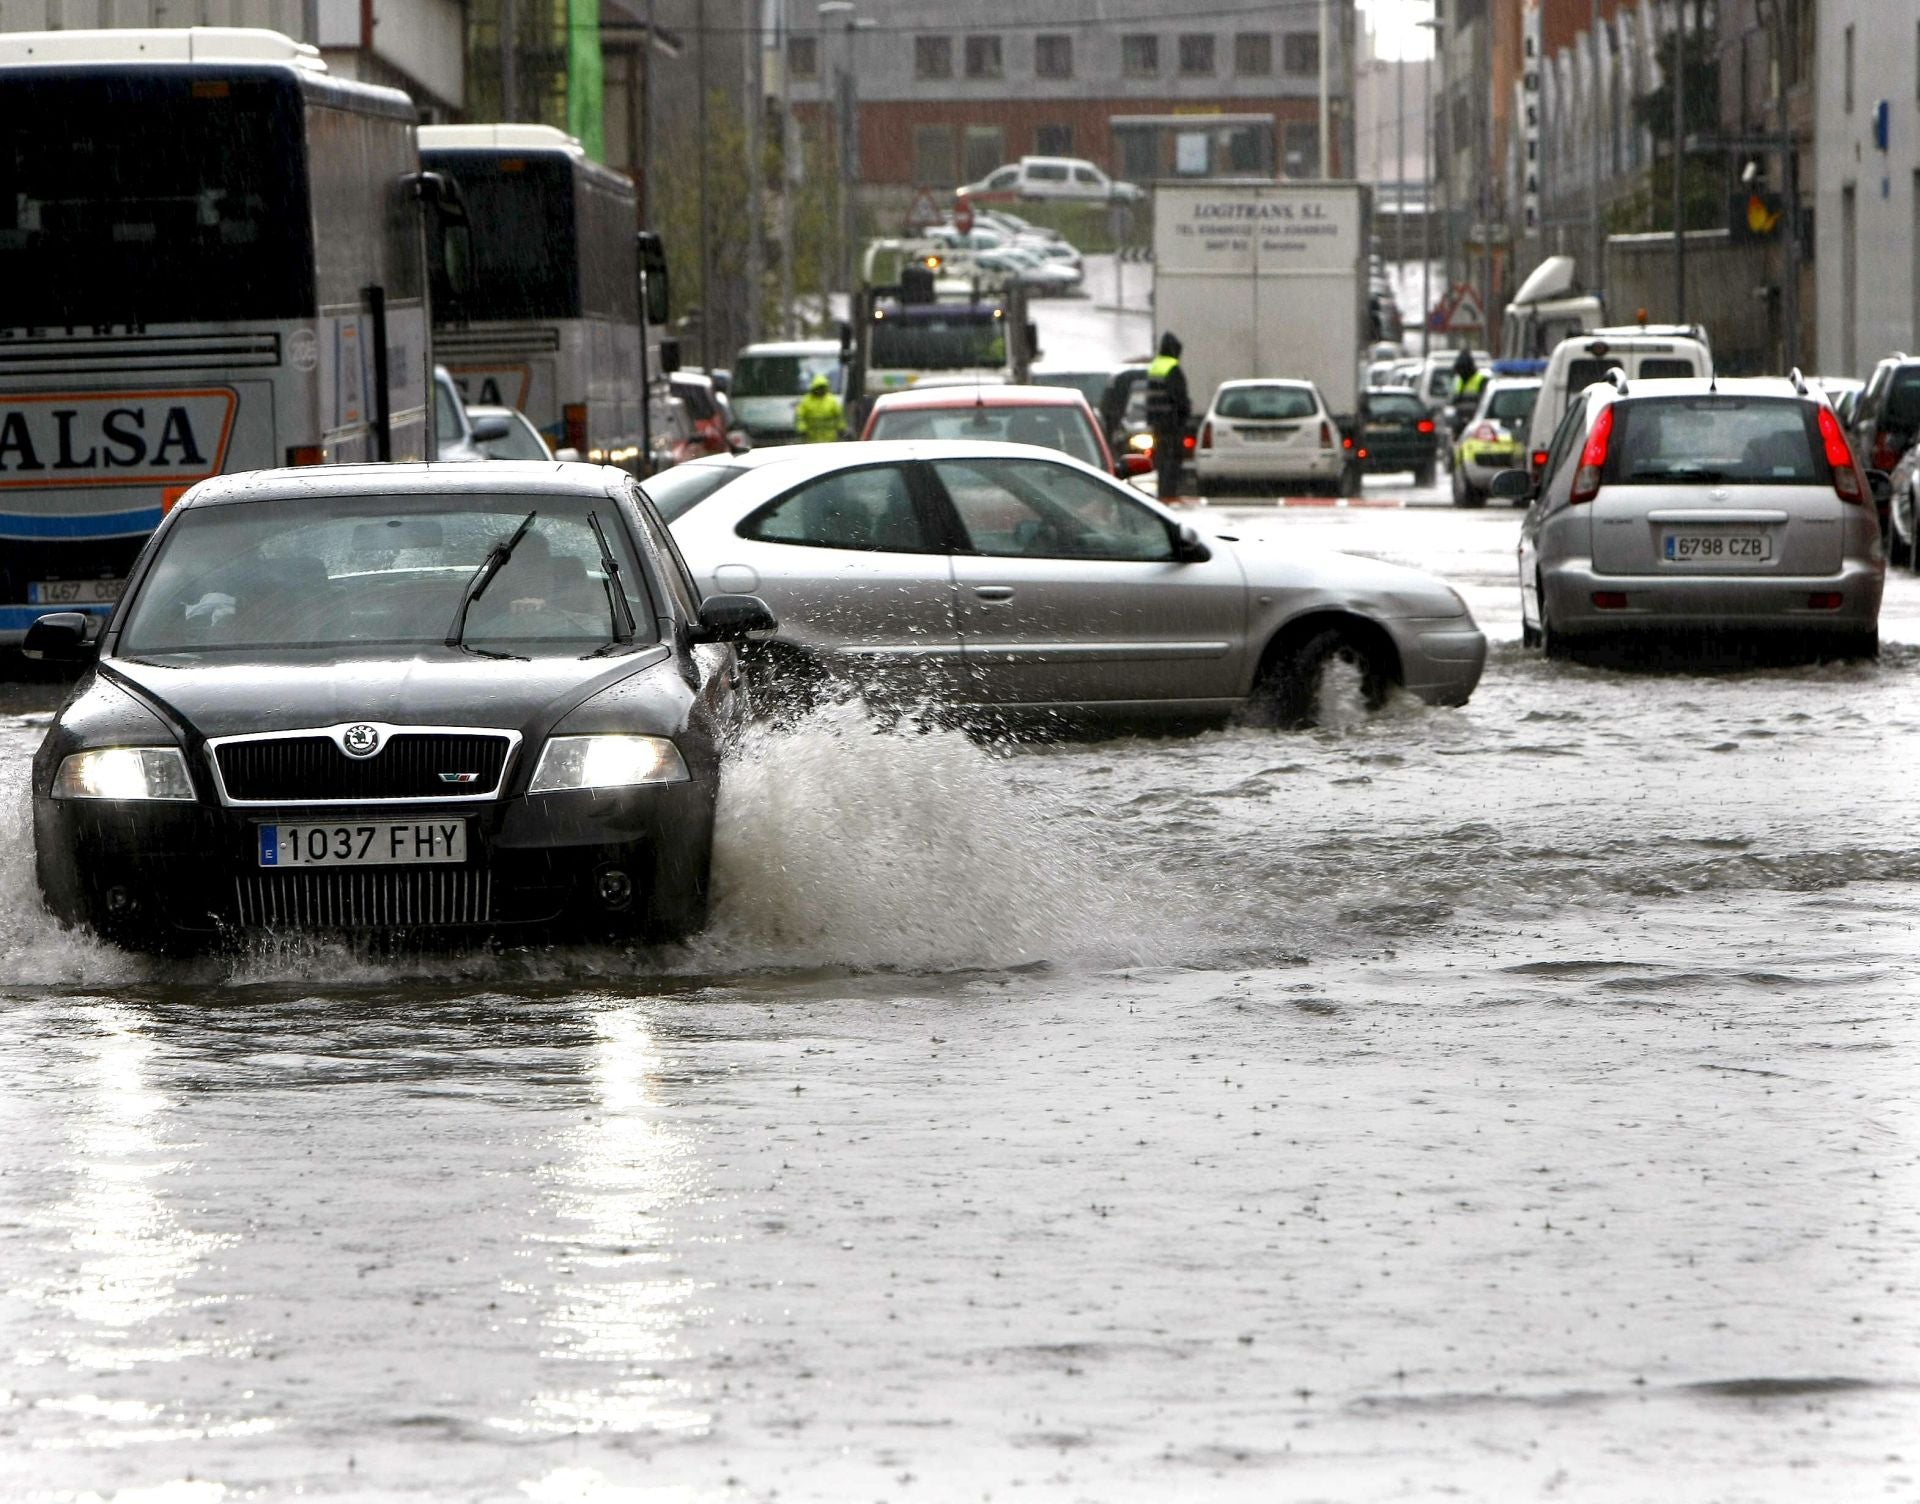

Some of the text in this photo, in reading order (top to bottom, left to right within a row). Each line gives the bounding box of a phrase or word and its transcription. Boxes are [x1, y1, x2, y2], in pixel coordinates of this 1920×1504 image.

[0, 406, 206, 471] ALSA
[1678, 537, 1763, 556] 6798 CZB
[41, 583, 81, 601] 1467
[289, 824, 458, 861] 1037 FHY
